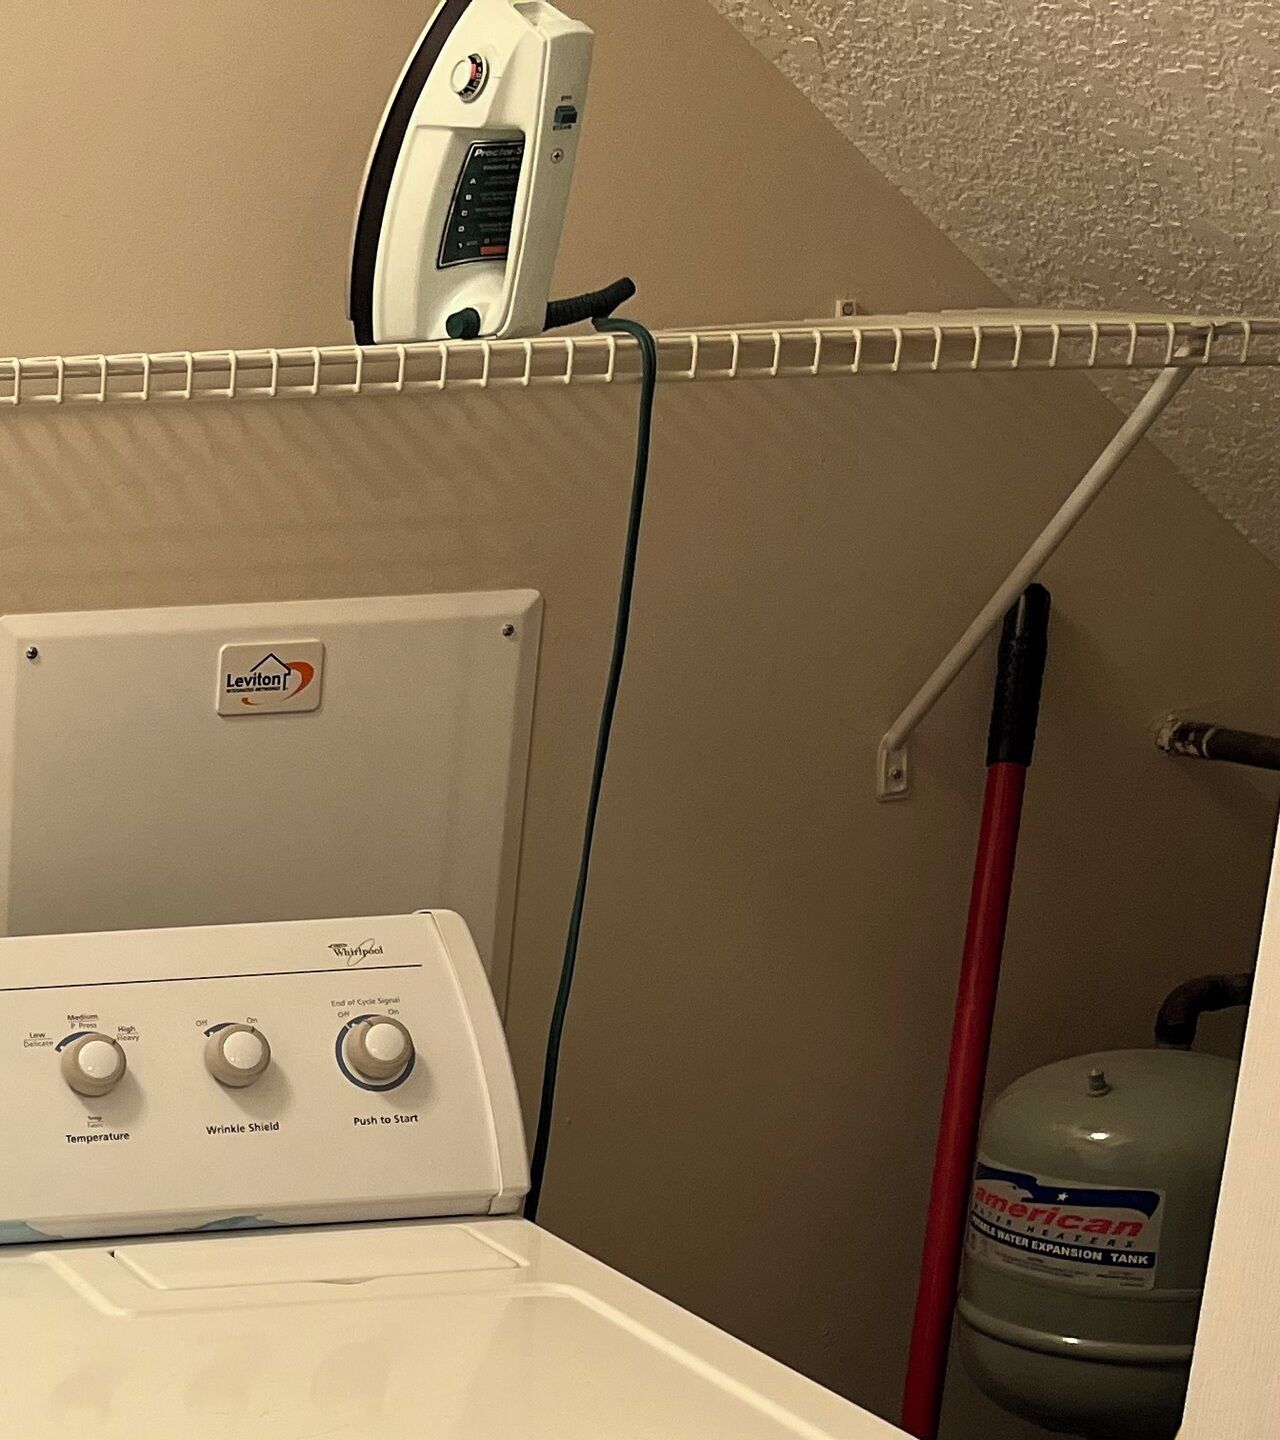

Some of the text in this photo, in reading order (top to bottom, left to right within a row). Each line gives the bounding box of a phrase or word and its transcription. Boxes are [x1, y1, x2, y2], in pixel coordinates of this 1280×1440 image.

[226, 672, 281, 688] Leviton
[333, 945, 384, 958] Whirlpool
[331, 996, 401, 1008] End of Cycle Signal
[336, 1011, 351, 1019] Off
[388, 1008, 400, 1016] On
[246, 1016, 258, 1024] On
[118, 1026, 136, 1034] High
[24, 1040, 54, 1048] Delicate
[116, 1034, 140, 1042] Heavy
[354, 1114, 419, 1126] Push to Start
[206, 1122, 280, 1135] Wrinkle Shield
[66, 1132, 130, 1144] Temperature
[975, 1186, 1145, 1237] american
[1026, 1226, 1135, 1248] HEATERS
[997, 1230, 1030, 1249] WATER
[1031, 1240, 1103, 1262] EXPANSION
[1109, 1252, 1150, 1266] TANK
